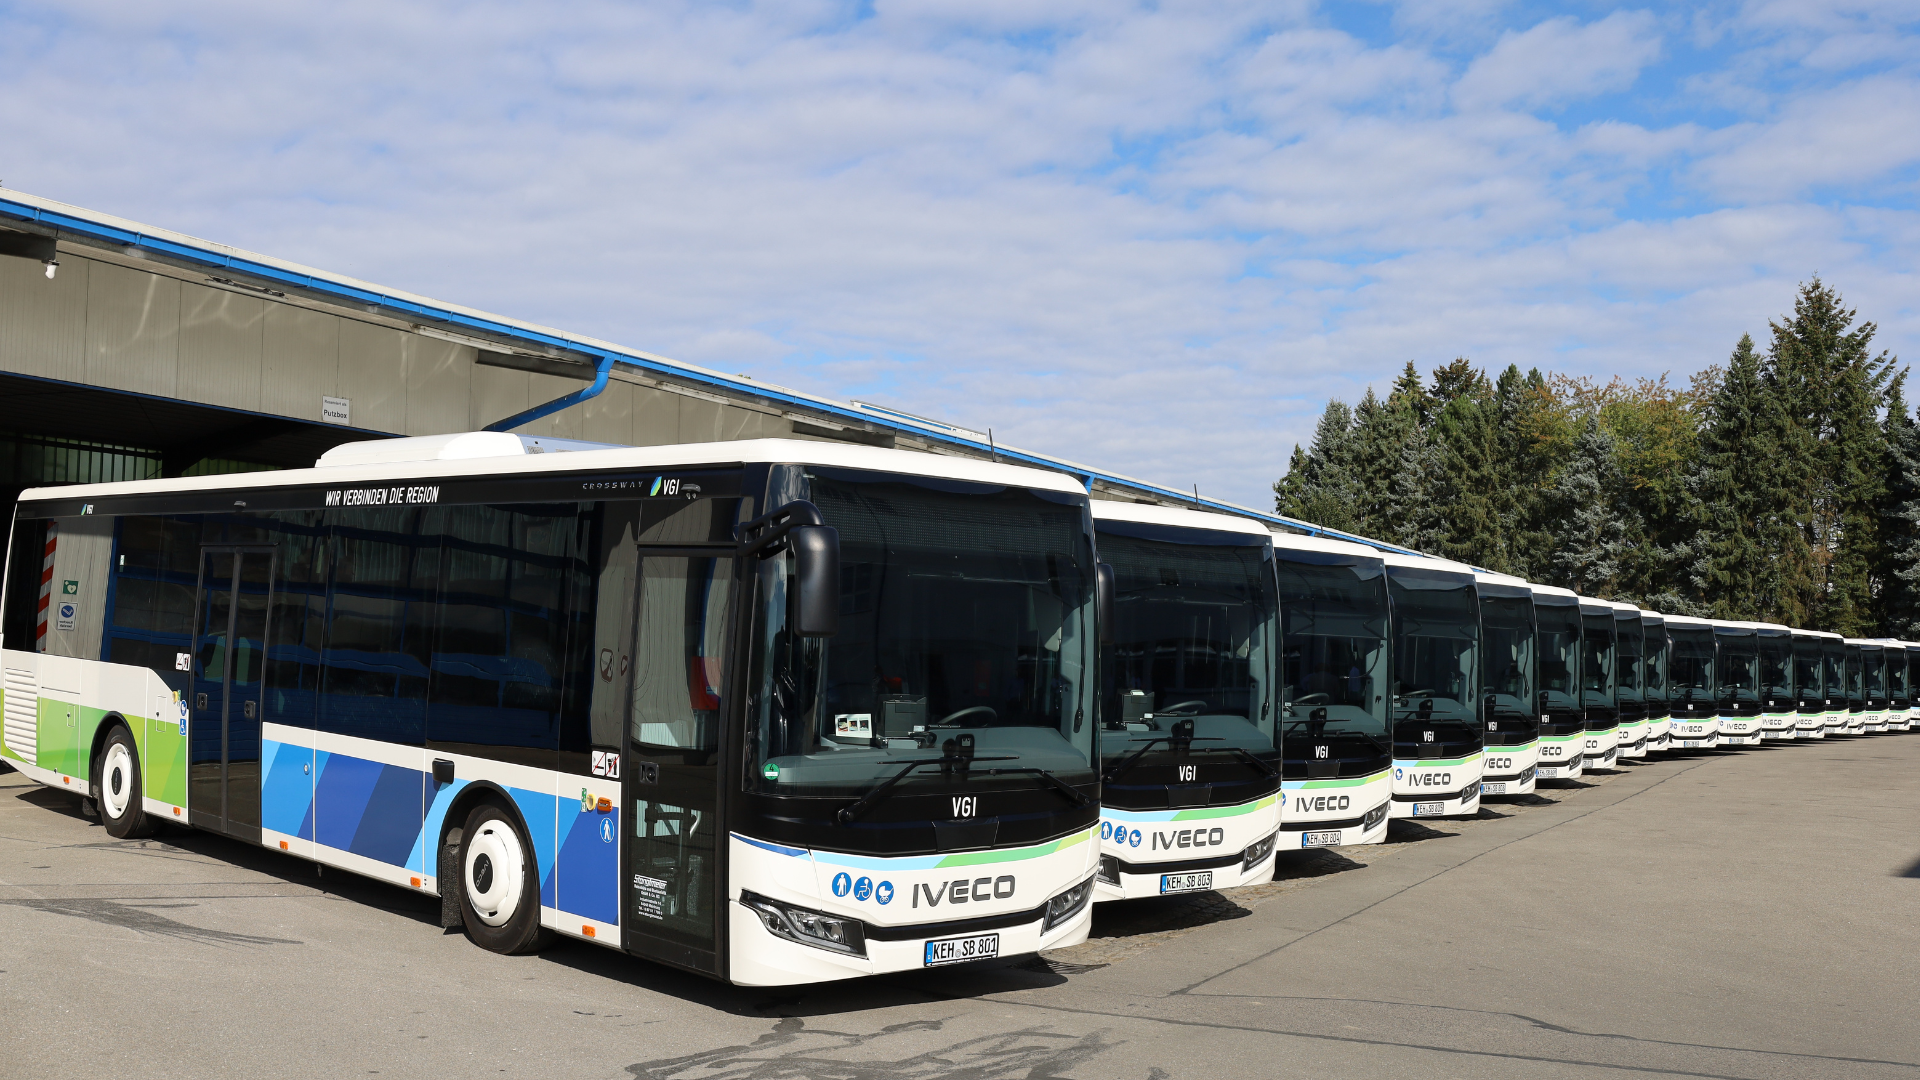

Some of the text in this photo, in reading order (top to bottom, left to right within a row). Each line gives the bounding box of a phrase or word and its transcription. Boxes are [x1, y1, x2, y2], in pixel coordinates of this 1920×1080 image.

[324, 409, 347, 419] Putzbox
[582, 481, 643, 490] CROSSWAY
[663, 479, 680, 495] VGI
[326, 486, 440, 506] WIR VERBINDEN DIE REGION
[1423, 731, 1434, 741] VGI
[1315, 746, 1328, 758] VGI
[770, 764, 774, 772] 4
[1179, 765, 1196, 781] VGI
[1409, 773, 1451, 786] IVECO
[952, 797, 976, 817] VGI
[1296, 796, 1349, 812] IVECO
[1152, 828, 1223, 850] IVECO
[1307, 834, 1318, 844] KEH
[1322, 834, 1328, 843] SB
[476, 860, 490, 887] IVECO
[1167, 874, 1210, 889] KEH SB 803
[912, 874, 1016, 908] IVECO
[933, 942, 955, 959] KEH
[962, 940, 975, 956] SB
[978, 937, 996, 954] 801
